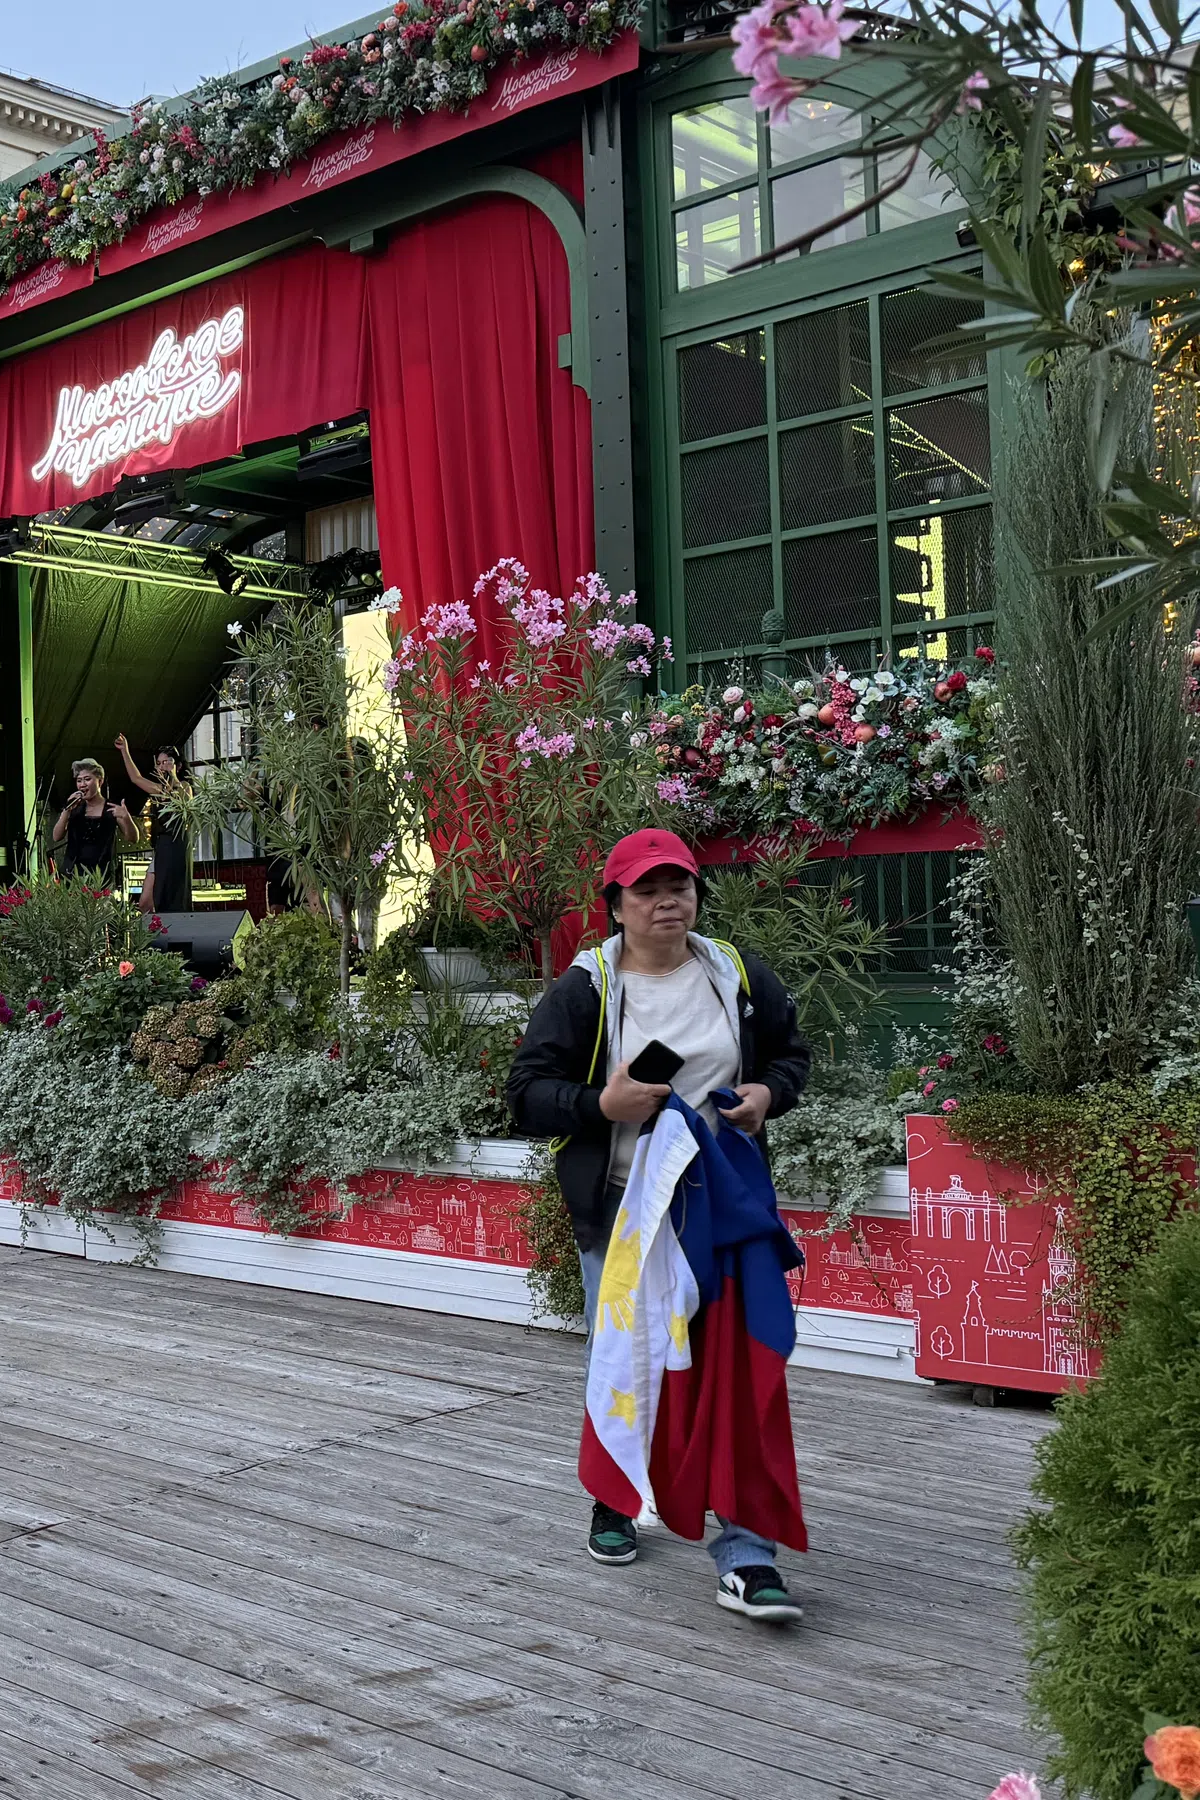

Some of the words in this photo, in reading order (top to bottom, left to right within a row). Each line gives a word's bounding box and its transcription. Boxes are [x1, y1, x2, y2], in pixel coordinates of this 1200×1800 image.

[491, 46, 578, 111] Московское
[501, 64, 577, 111] чаепитие
[301, 130, 375, 187] Московское
[310, 146, 373, 188] чаепитие
[31, 304, 244, 481] Московское
[53, 359, 242, 488] чаепитие
